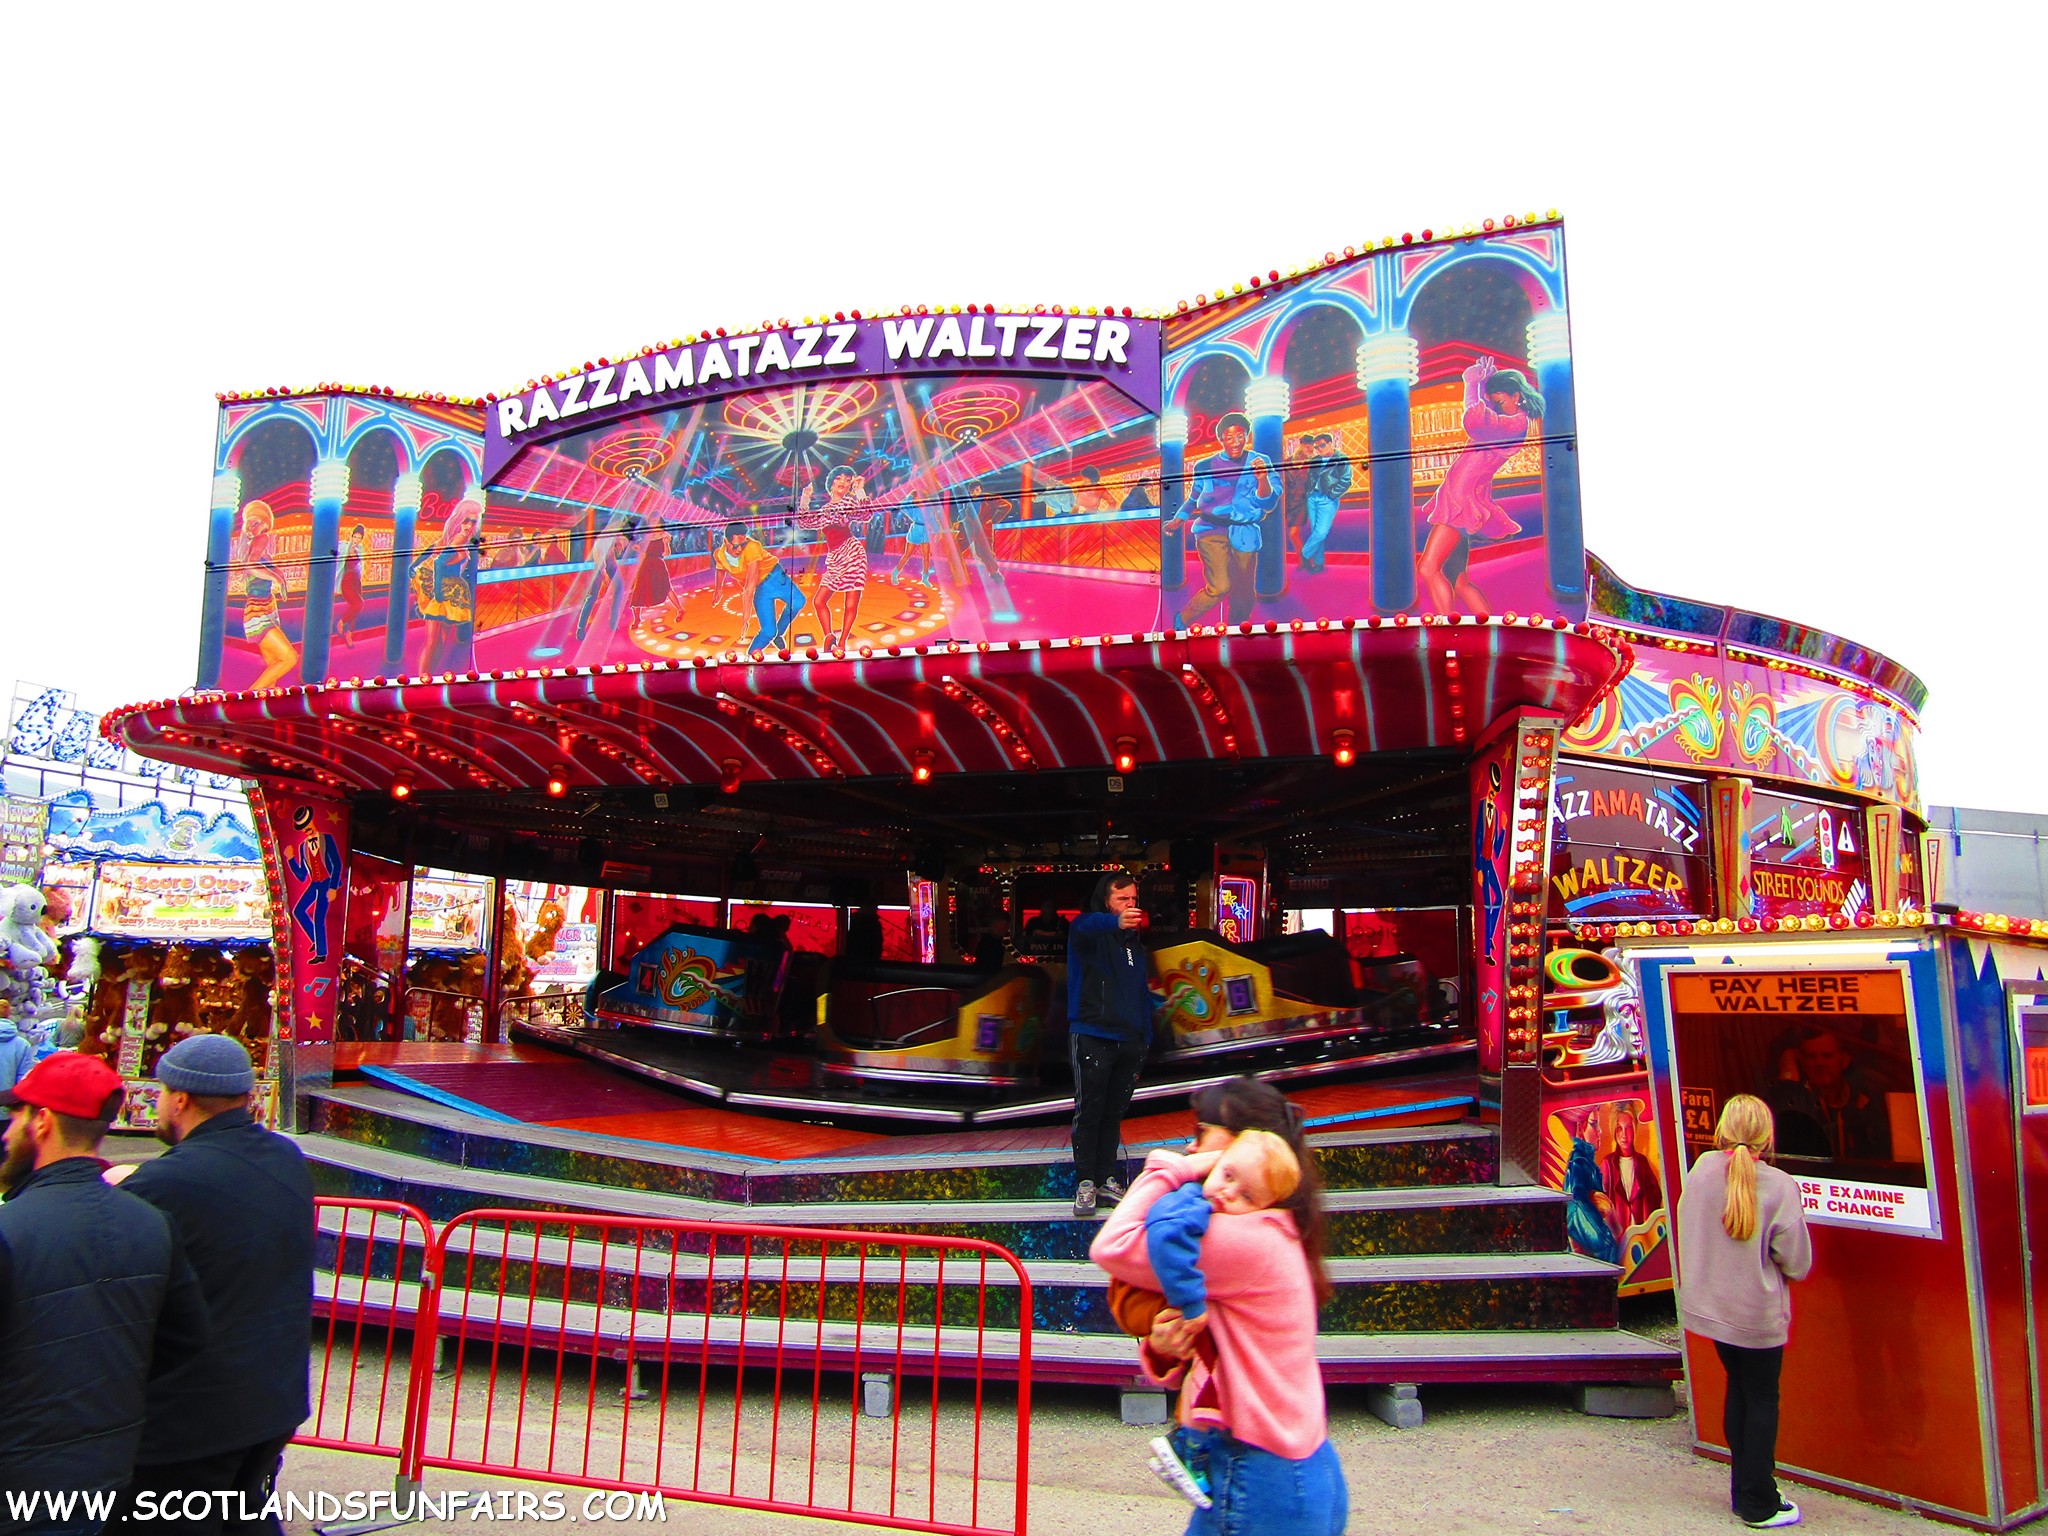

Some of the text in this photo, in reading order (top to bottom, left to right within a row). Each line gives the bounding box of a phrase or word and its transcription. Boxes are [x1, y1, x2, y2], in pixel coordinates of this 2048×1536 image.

[496, 316, 1131, 438] RAZZAMATAZZ WALTZER
[1552, 789, 1699, 853] AZZAMATAZZ
[135, 875, 194, 891] Score
[199, 874, 249, 891] Over
[1551, 856, 1683, 902] WALTZER
[1753, 870, 1845, 904] STREET SOUNDS
[413, 890, 442, 905] ver
[210, 917, 250, 928] Highland
[557, 929, 581, 940] VER
[1126, 947, 1134, 967] NIKE
[1709, 977, 1860, 994] PAY HERE
[1715, 995, 1859, 1012] WALTZER
[1681, 1090, 1710, 1107] Fare
[1685, 1109, 1710, 1130] £4
[1829, 1185, 1905, 1205] EXAMINE
[1826, 1200, 1895, 1219] CHANGE
